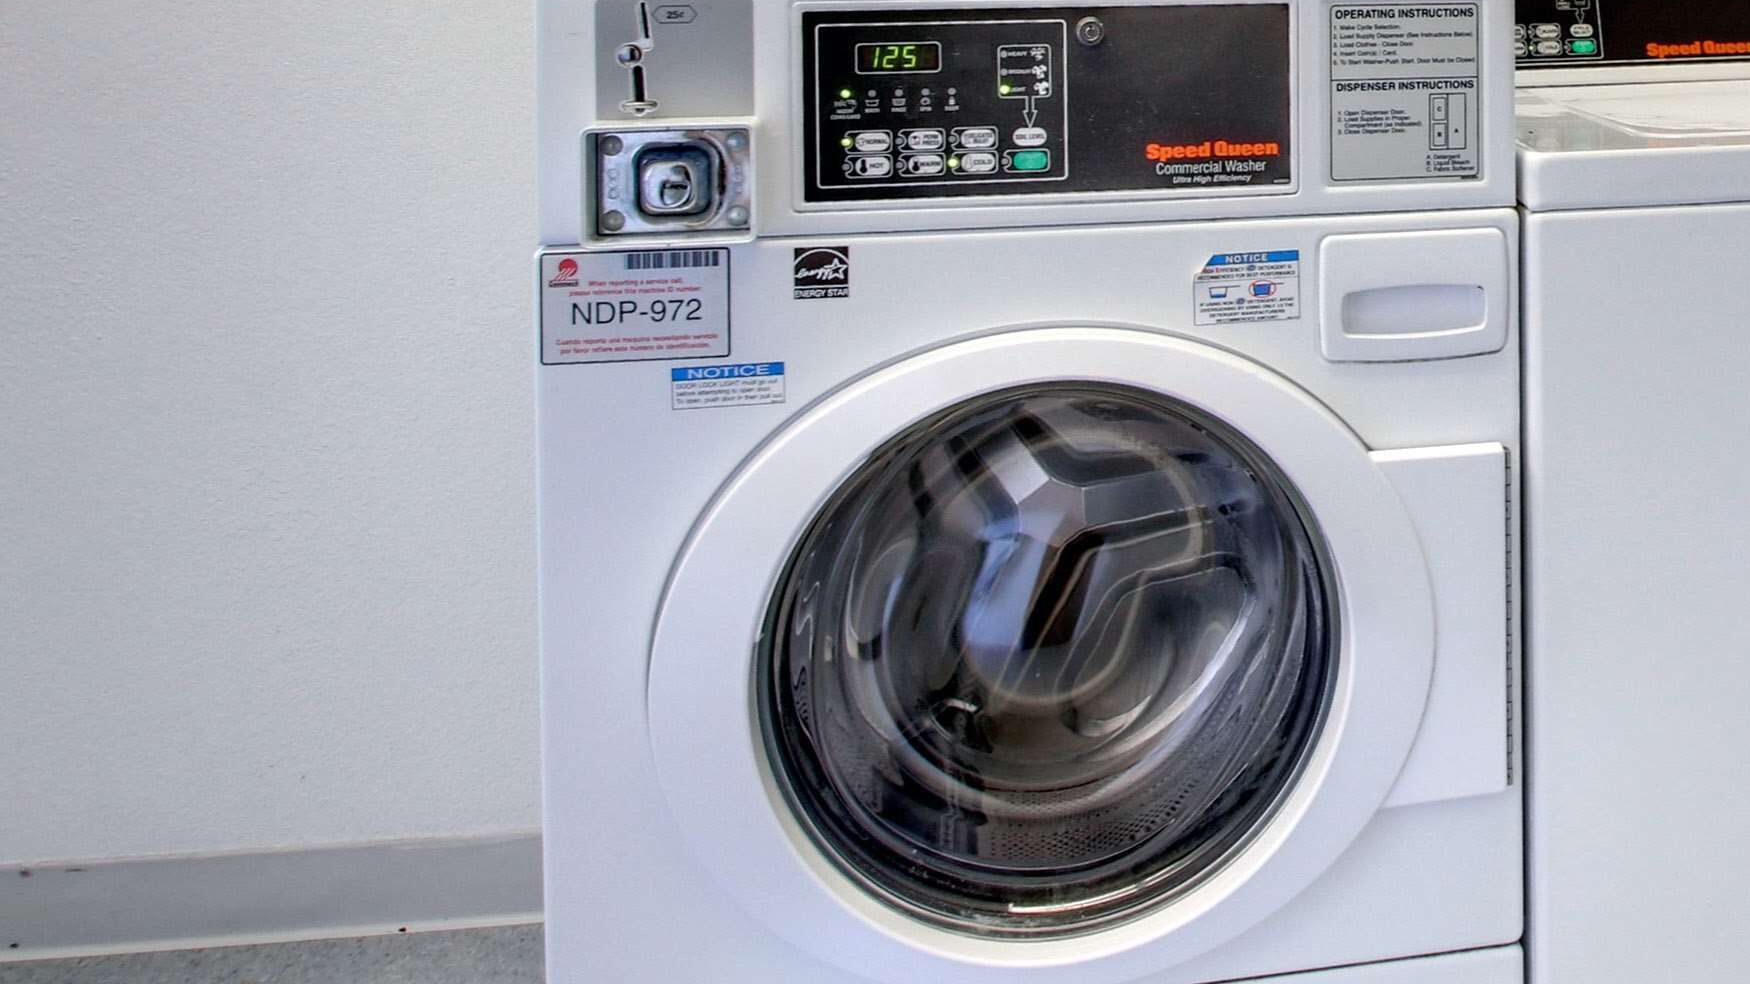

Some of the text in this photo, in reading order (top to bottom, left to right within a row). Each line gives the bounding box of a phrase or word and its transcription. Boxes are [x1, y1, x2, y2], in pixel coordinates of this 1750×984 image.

[1335, 8, 1474, 20] OPERATING INSTRUCTIONS
[872, 46, 917, 68] 125
[1646, 42, 1700, 58] Speed
[1336, 80, 1474, 92] DISPENSER INSTRUCTIONS
[1146, 141, 1279, 162] Speed Queen
[1156, 160, 1267, 176] Commercial Washer
[1173, 174, 1252, 184] Ultra High Efficiency
[1225, 253, 1268, 263] NOTICE
[572, 298, 703, 325] NDP-972
[687, 364, 769, 379] NOTICE
